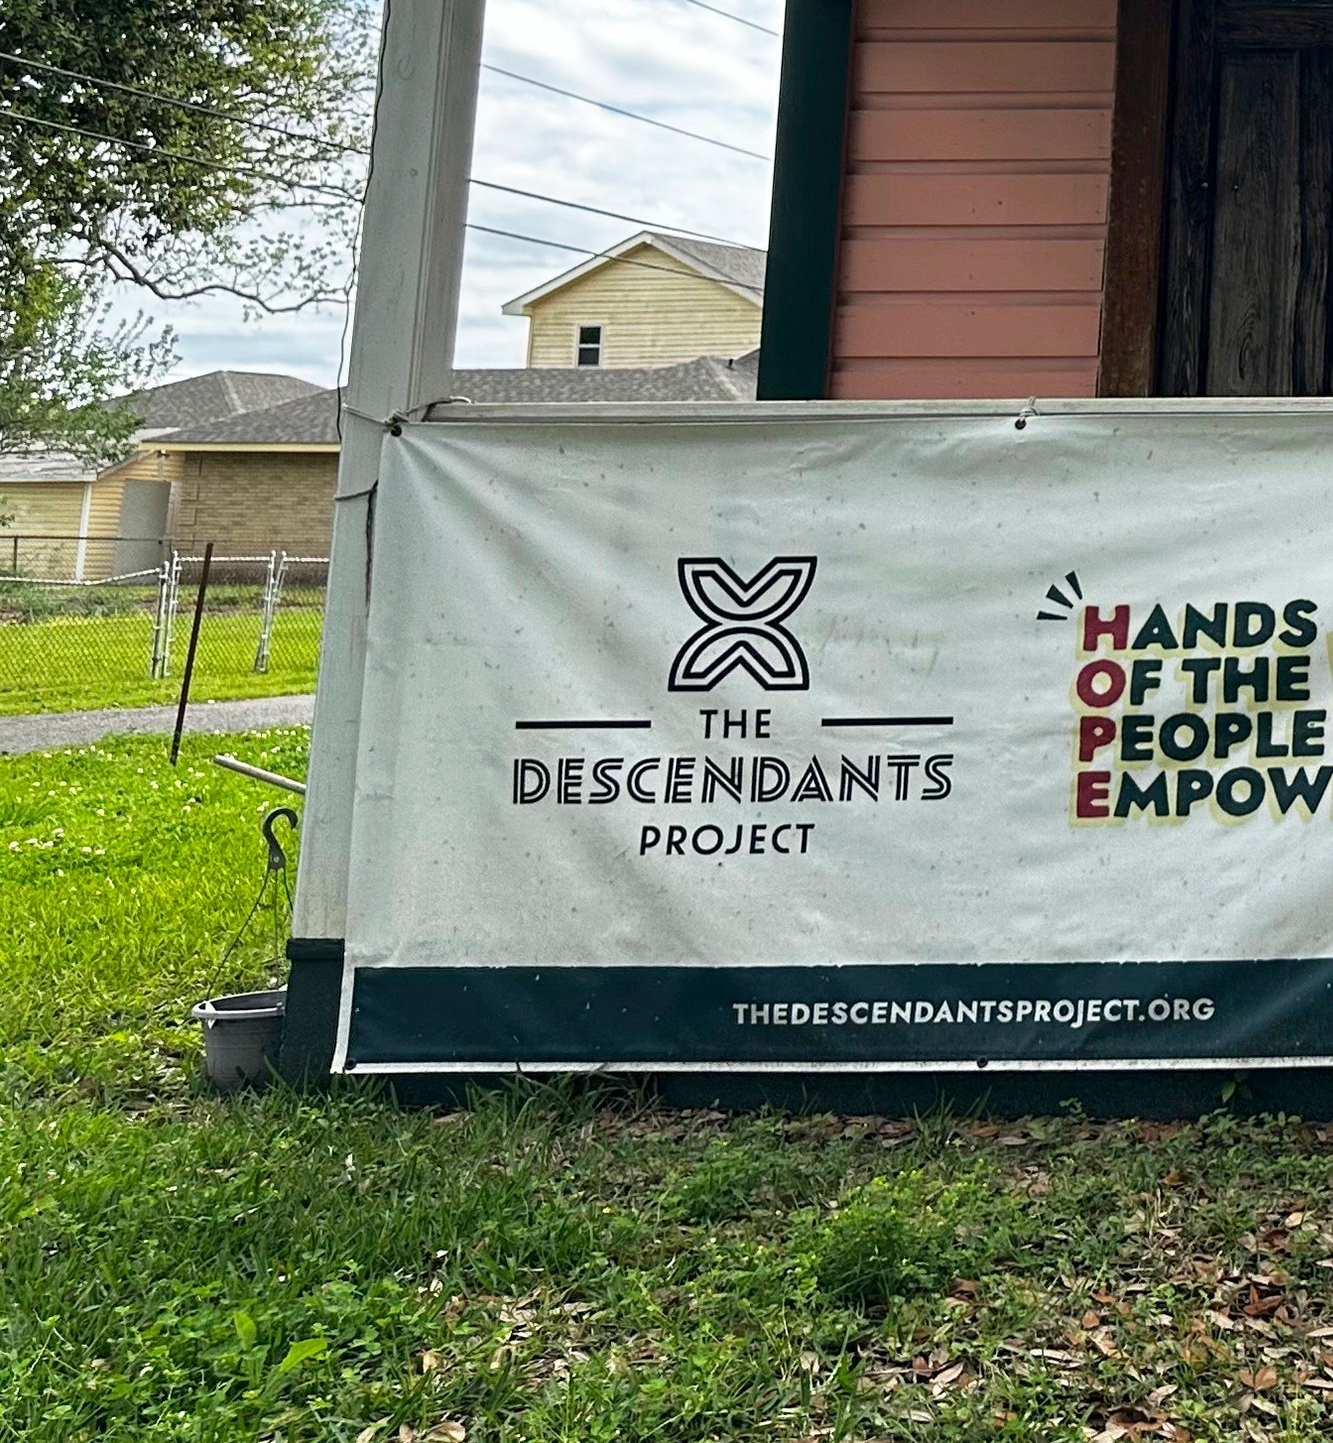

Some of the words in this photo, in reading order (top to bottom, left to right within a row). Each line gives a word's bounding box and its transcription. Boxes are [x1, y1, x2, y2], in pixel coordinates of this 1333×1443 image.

[1082, 599, 1319, 652] HANDS
[1076, 659, 1163, 709] OF
[1181, 655, 1311, 704] THE
[699, 709, 772, 740] THE
[1078, 709, 1327, 762] PEOPLE
[512, 754, 954, 805] DESCENDANTS
[638, 823, 816, 856] PROJECT
[732, 997, 1216, 1029] THEDESCENDANTSPROJECT.ORG
